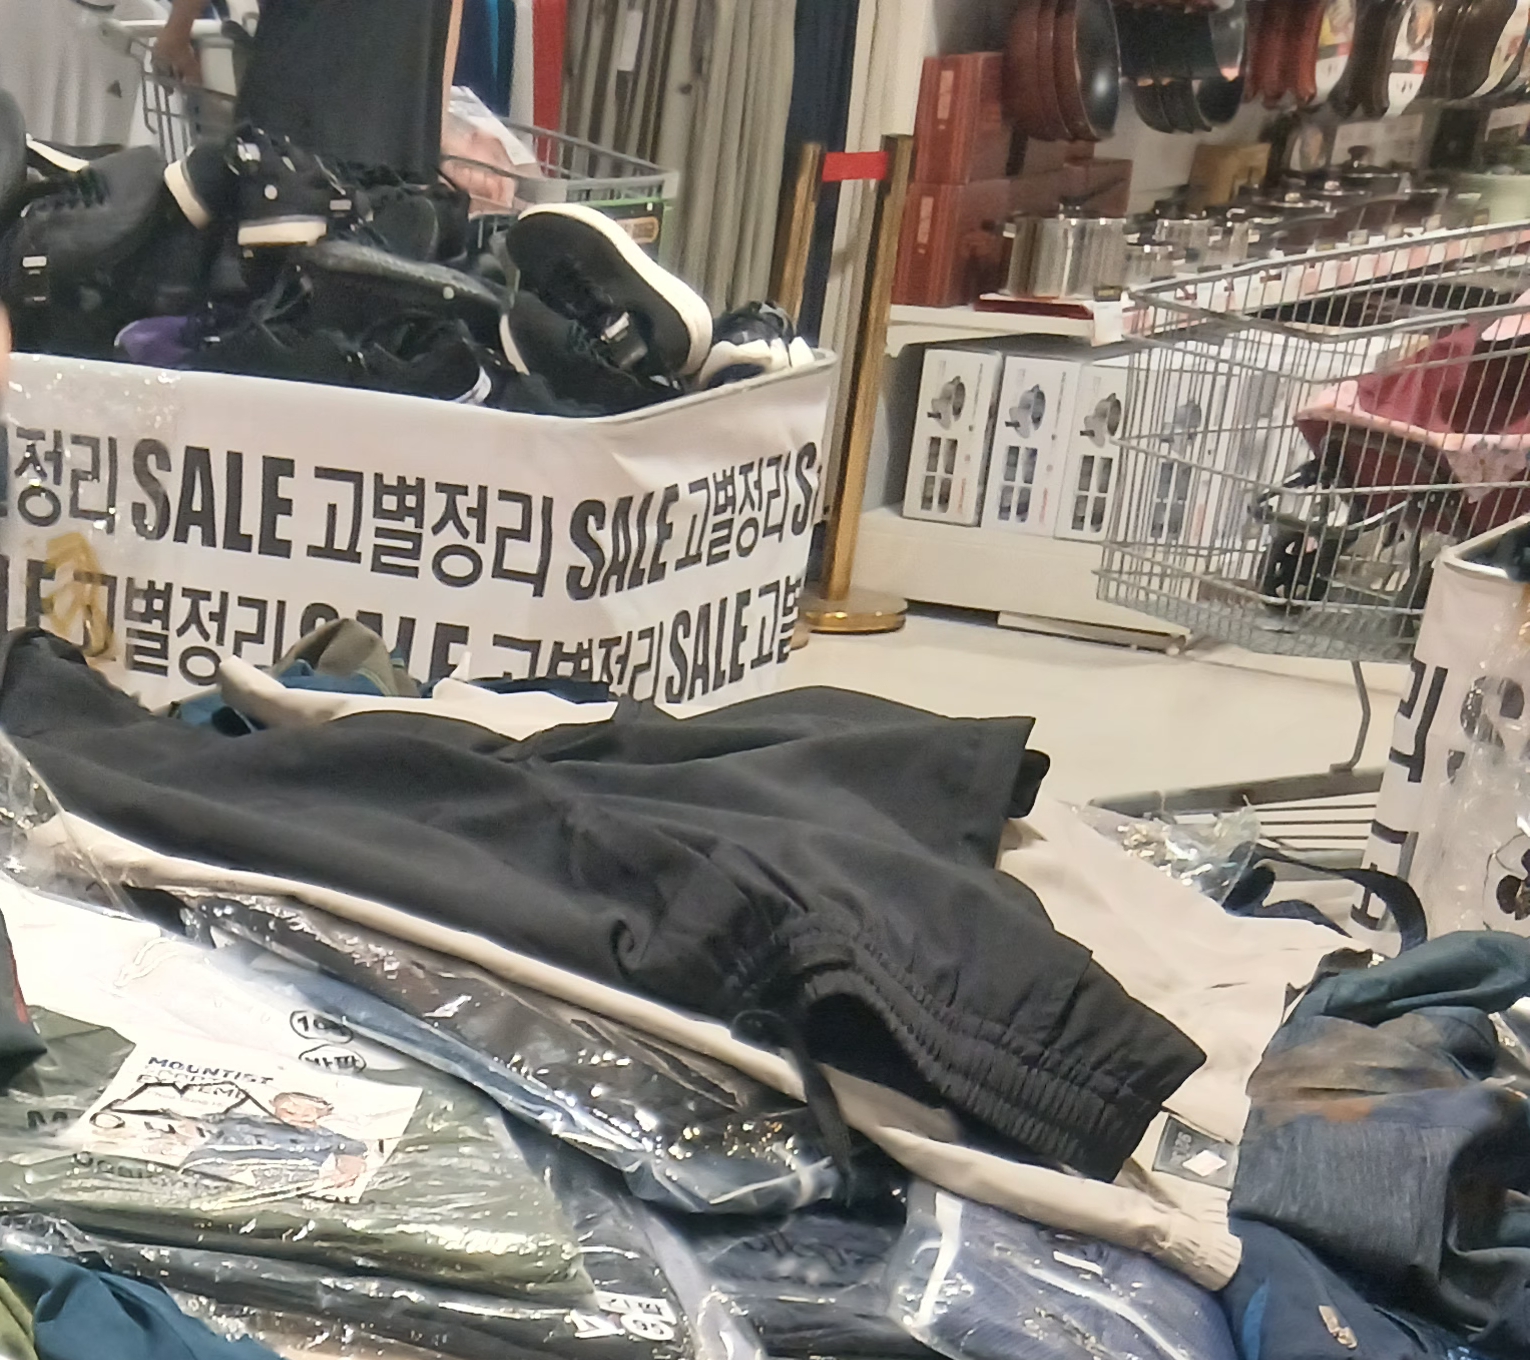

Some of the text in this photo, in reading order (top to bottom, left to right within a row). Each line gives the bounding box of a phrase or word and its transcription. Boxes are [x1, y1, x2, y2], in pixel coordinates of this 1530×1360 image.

[129, 437, 296, 559] SALE
[306, 465, 554, 599] 고별정리
[566, 483, 680, 601] SALE
[674, 449, 792, 574] 고별정리
[665, 588, 752, 705] SALE
